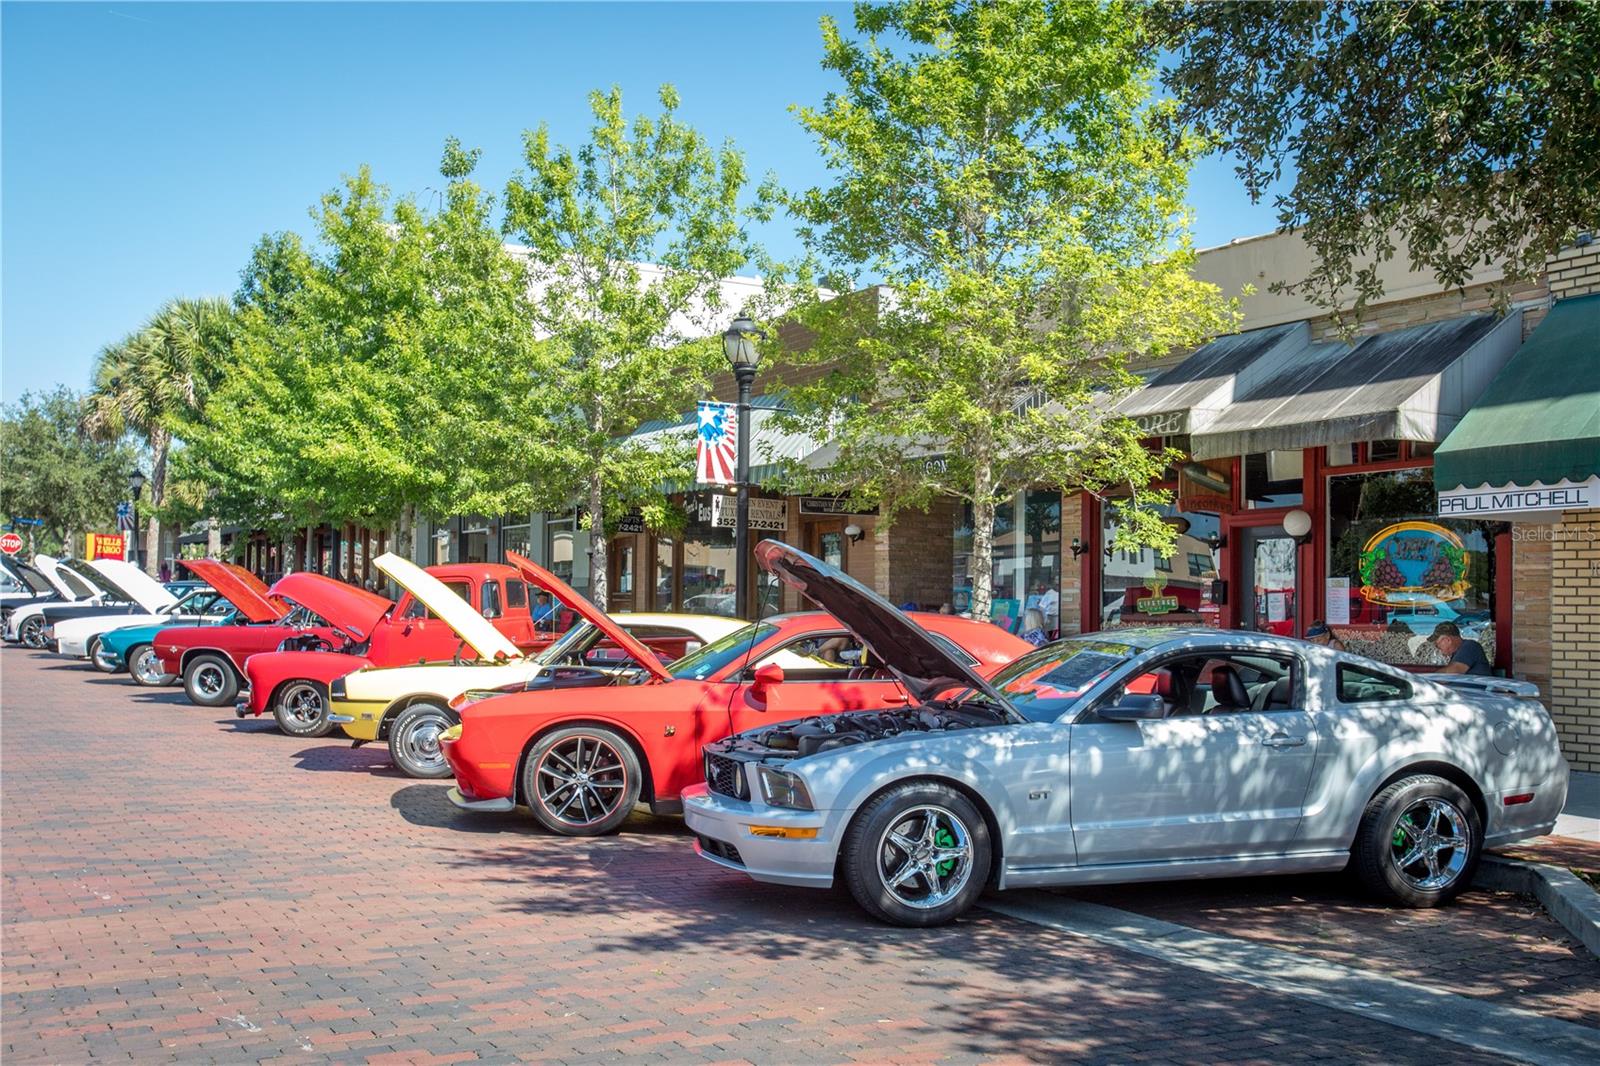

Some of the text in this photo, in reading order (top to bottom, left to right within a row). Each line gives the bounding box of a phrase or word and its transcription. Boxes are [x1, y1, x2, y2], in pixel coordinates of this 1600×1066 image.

[1135, 412, 1183, 434] ORE
[1439, 489, 1588, 512] PAUL MITCHELL
[2, 539, 20, 548] STOP
[96, 537, 121, 545] WELLS
[97, 545, 121, 554] FARGO
